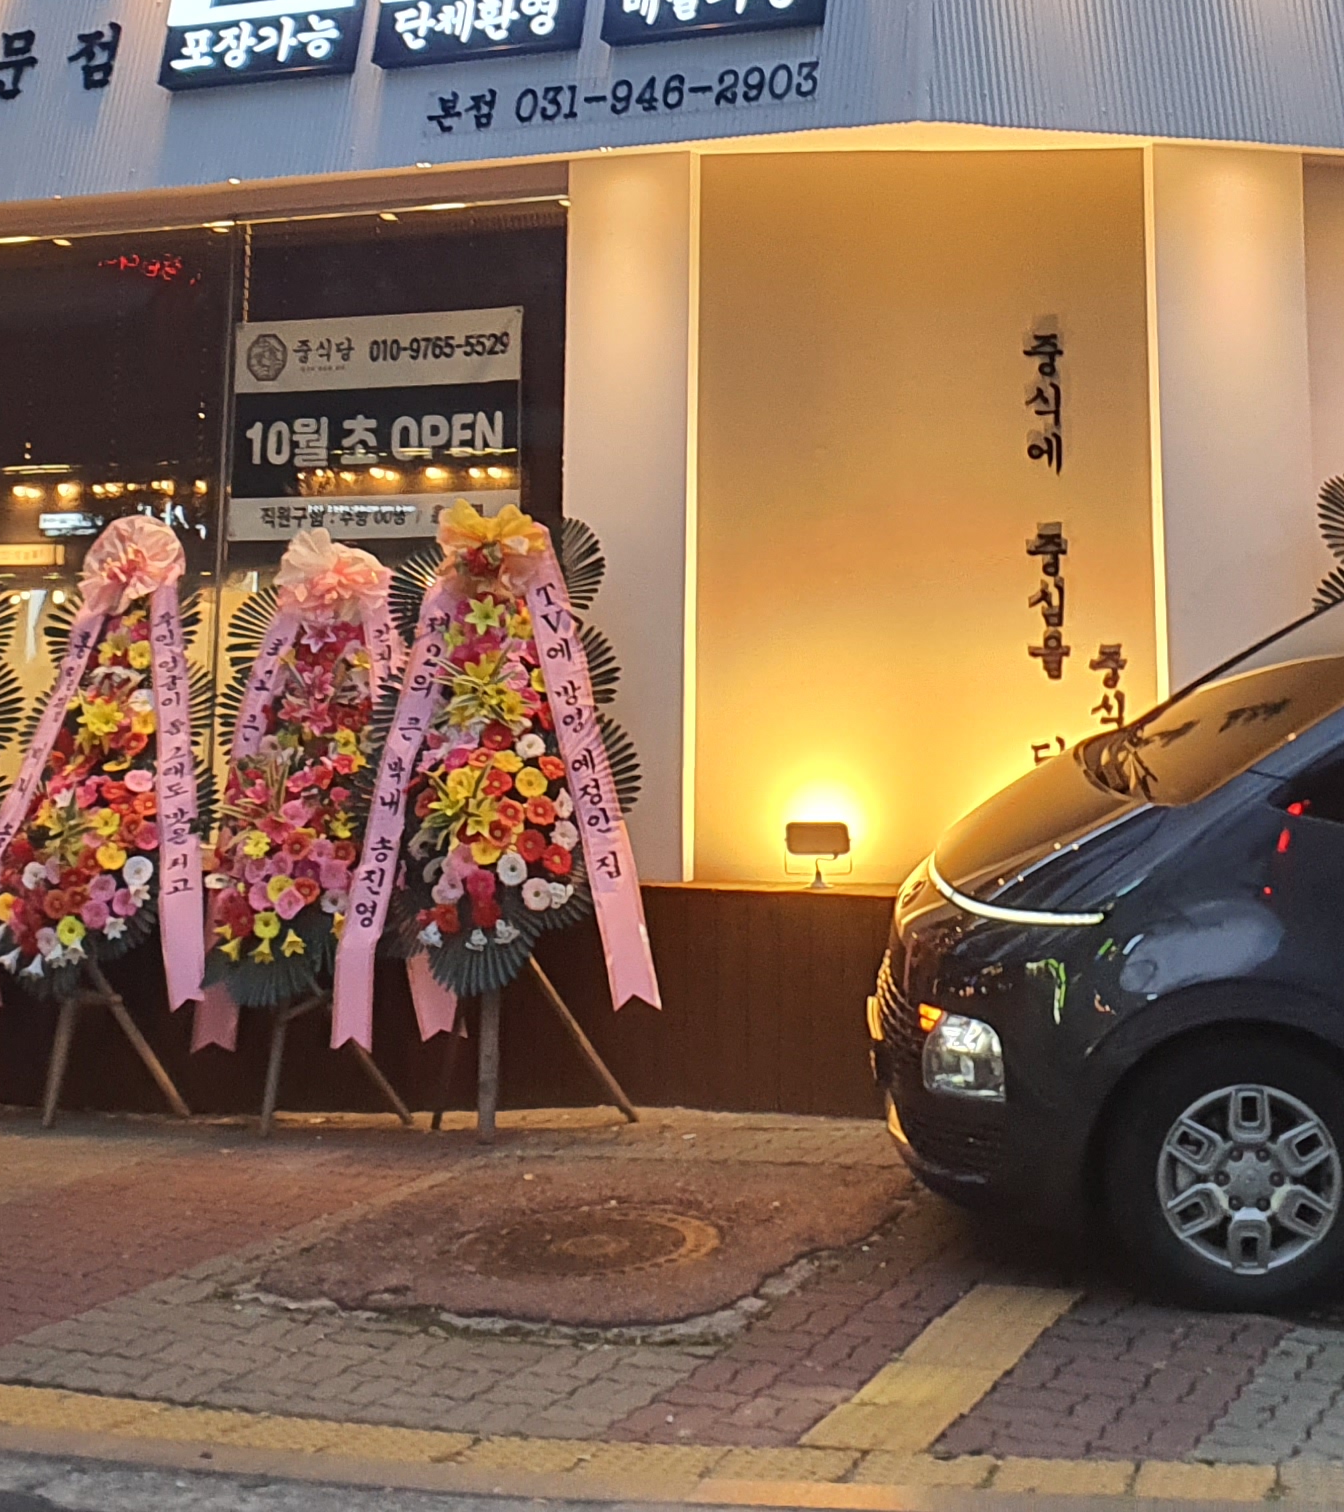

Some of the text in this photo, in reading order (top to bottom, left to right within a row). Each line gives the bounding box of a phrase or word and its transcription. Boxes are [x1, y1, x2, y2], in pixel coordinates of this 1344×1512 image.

[169, 16, 342, 73] 포장가능
[426, 58, 821, 134] 본점 031-946-2903
[292, 336, 355, 364] 중식당
[368, 331, 510, 363] 010-9765-5529
[1022, 332, 1064, 476] 중식에
[245, 415, 330, 468] 10월
[391, 410, 505, 462] OPEN
[1025, 524, 1072, 680] 중심을
